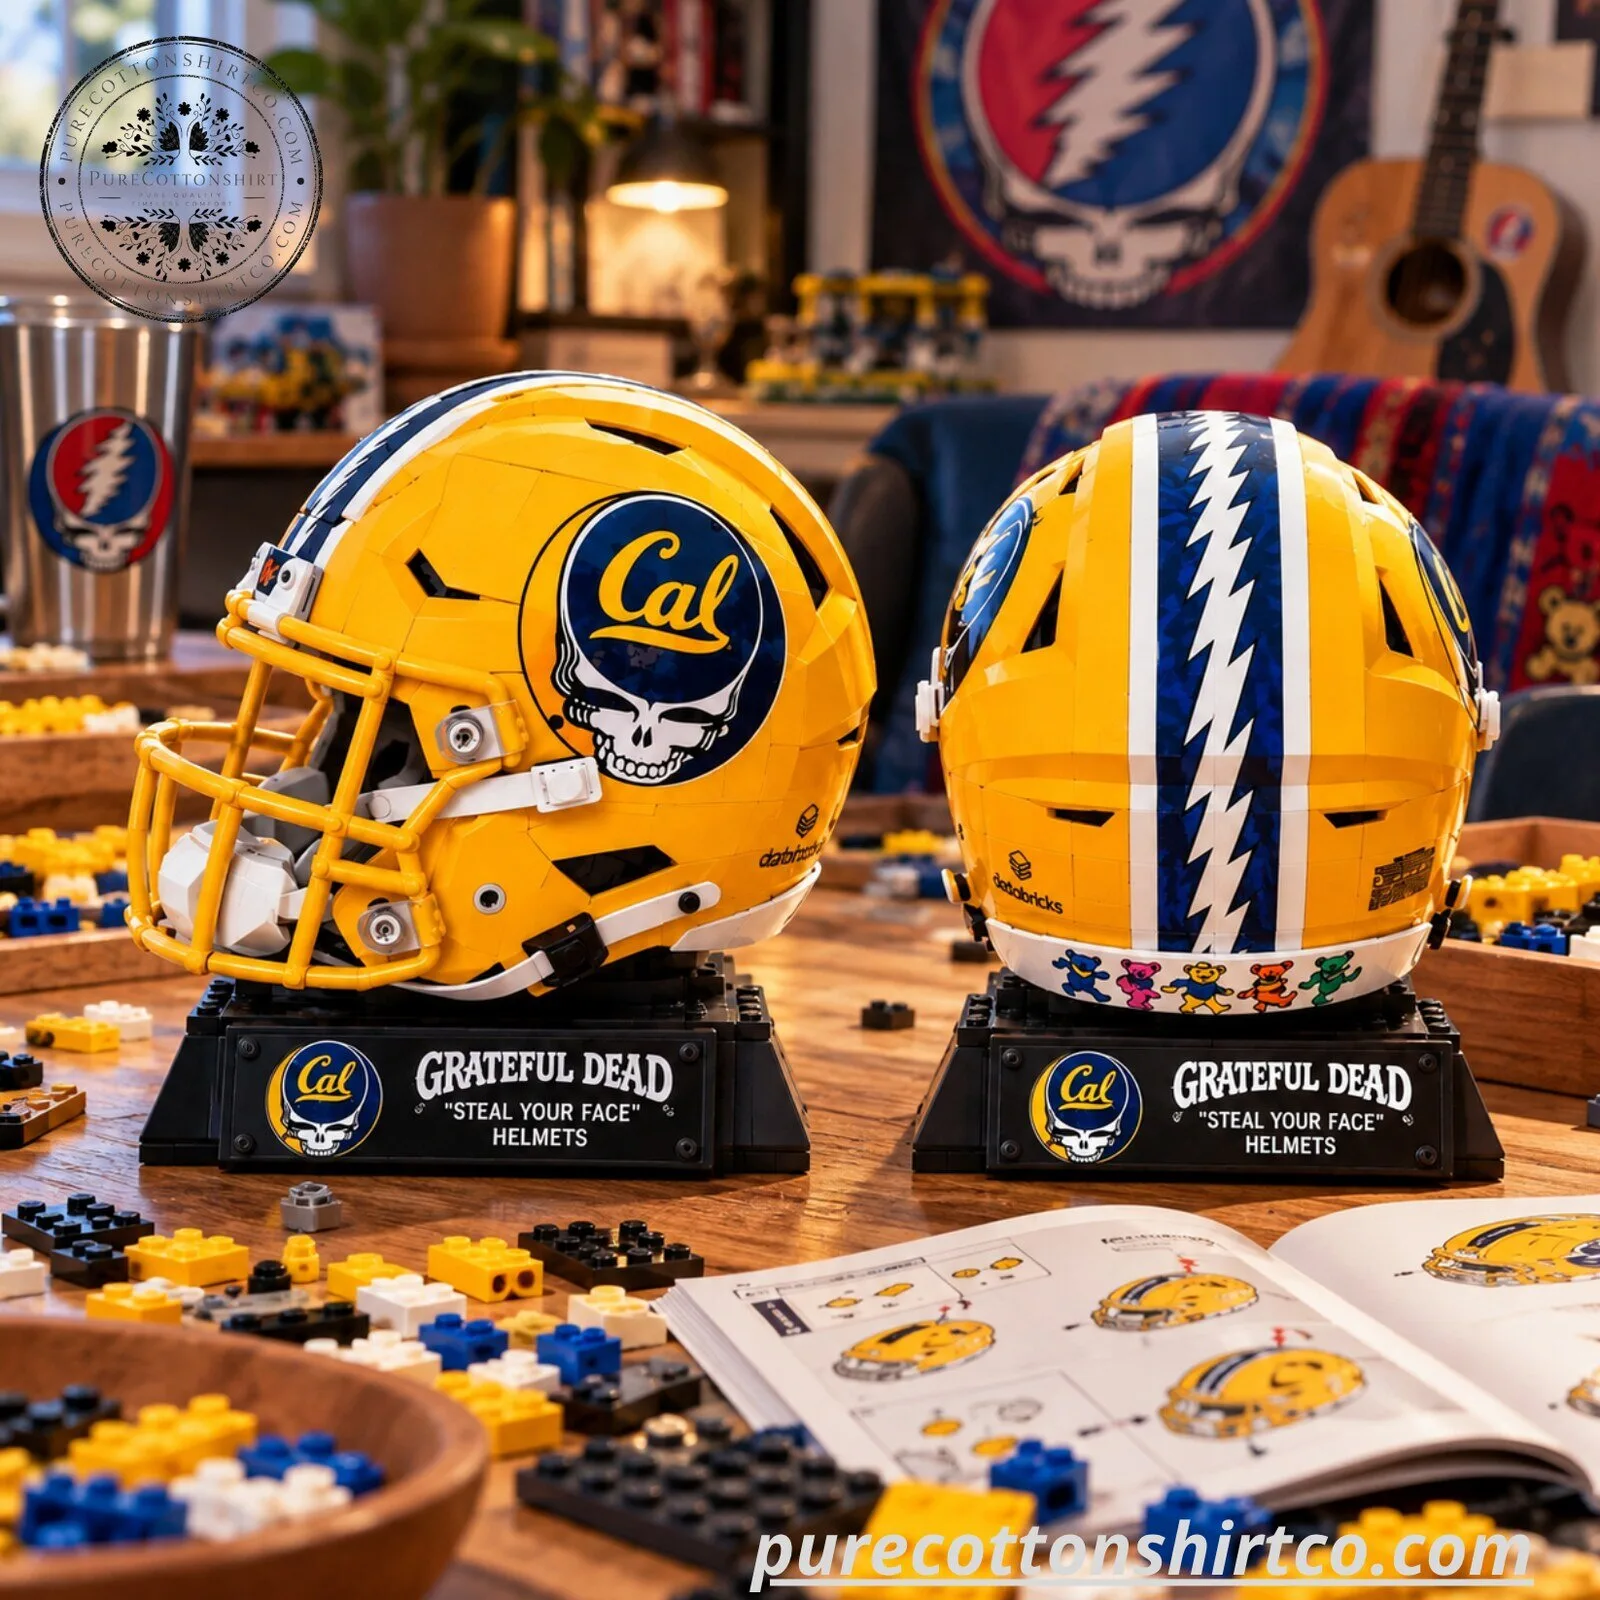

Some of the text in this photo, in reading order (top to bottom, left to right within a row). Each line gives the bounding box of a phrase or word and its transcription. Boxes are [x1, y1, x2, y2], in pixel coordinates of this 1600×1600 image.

[589, 530, 739, 654] Cal
[993, 872, 1063, 914] databricks
[295, 1056, 355, 1102] Cal
[415, 1051, 673, 1102] GRATEFUL DEAD
[1058, 1064, 1117, 1111] Cal
[1172, 1061, 1413, 1111] GRATEFUL DEAD
[445, 1102, 641, 1122] "STEAL YOUR FACE"
[1199, 1111, 1384, 1131] "STEAL YOUR FACE"
[493, 1128, 588, 1147] HELMETS
[1246, 1136, 1336, 1155] HELMETS
